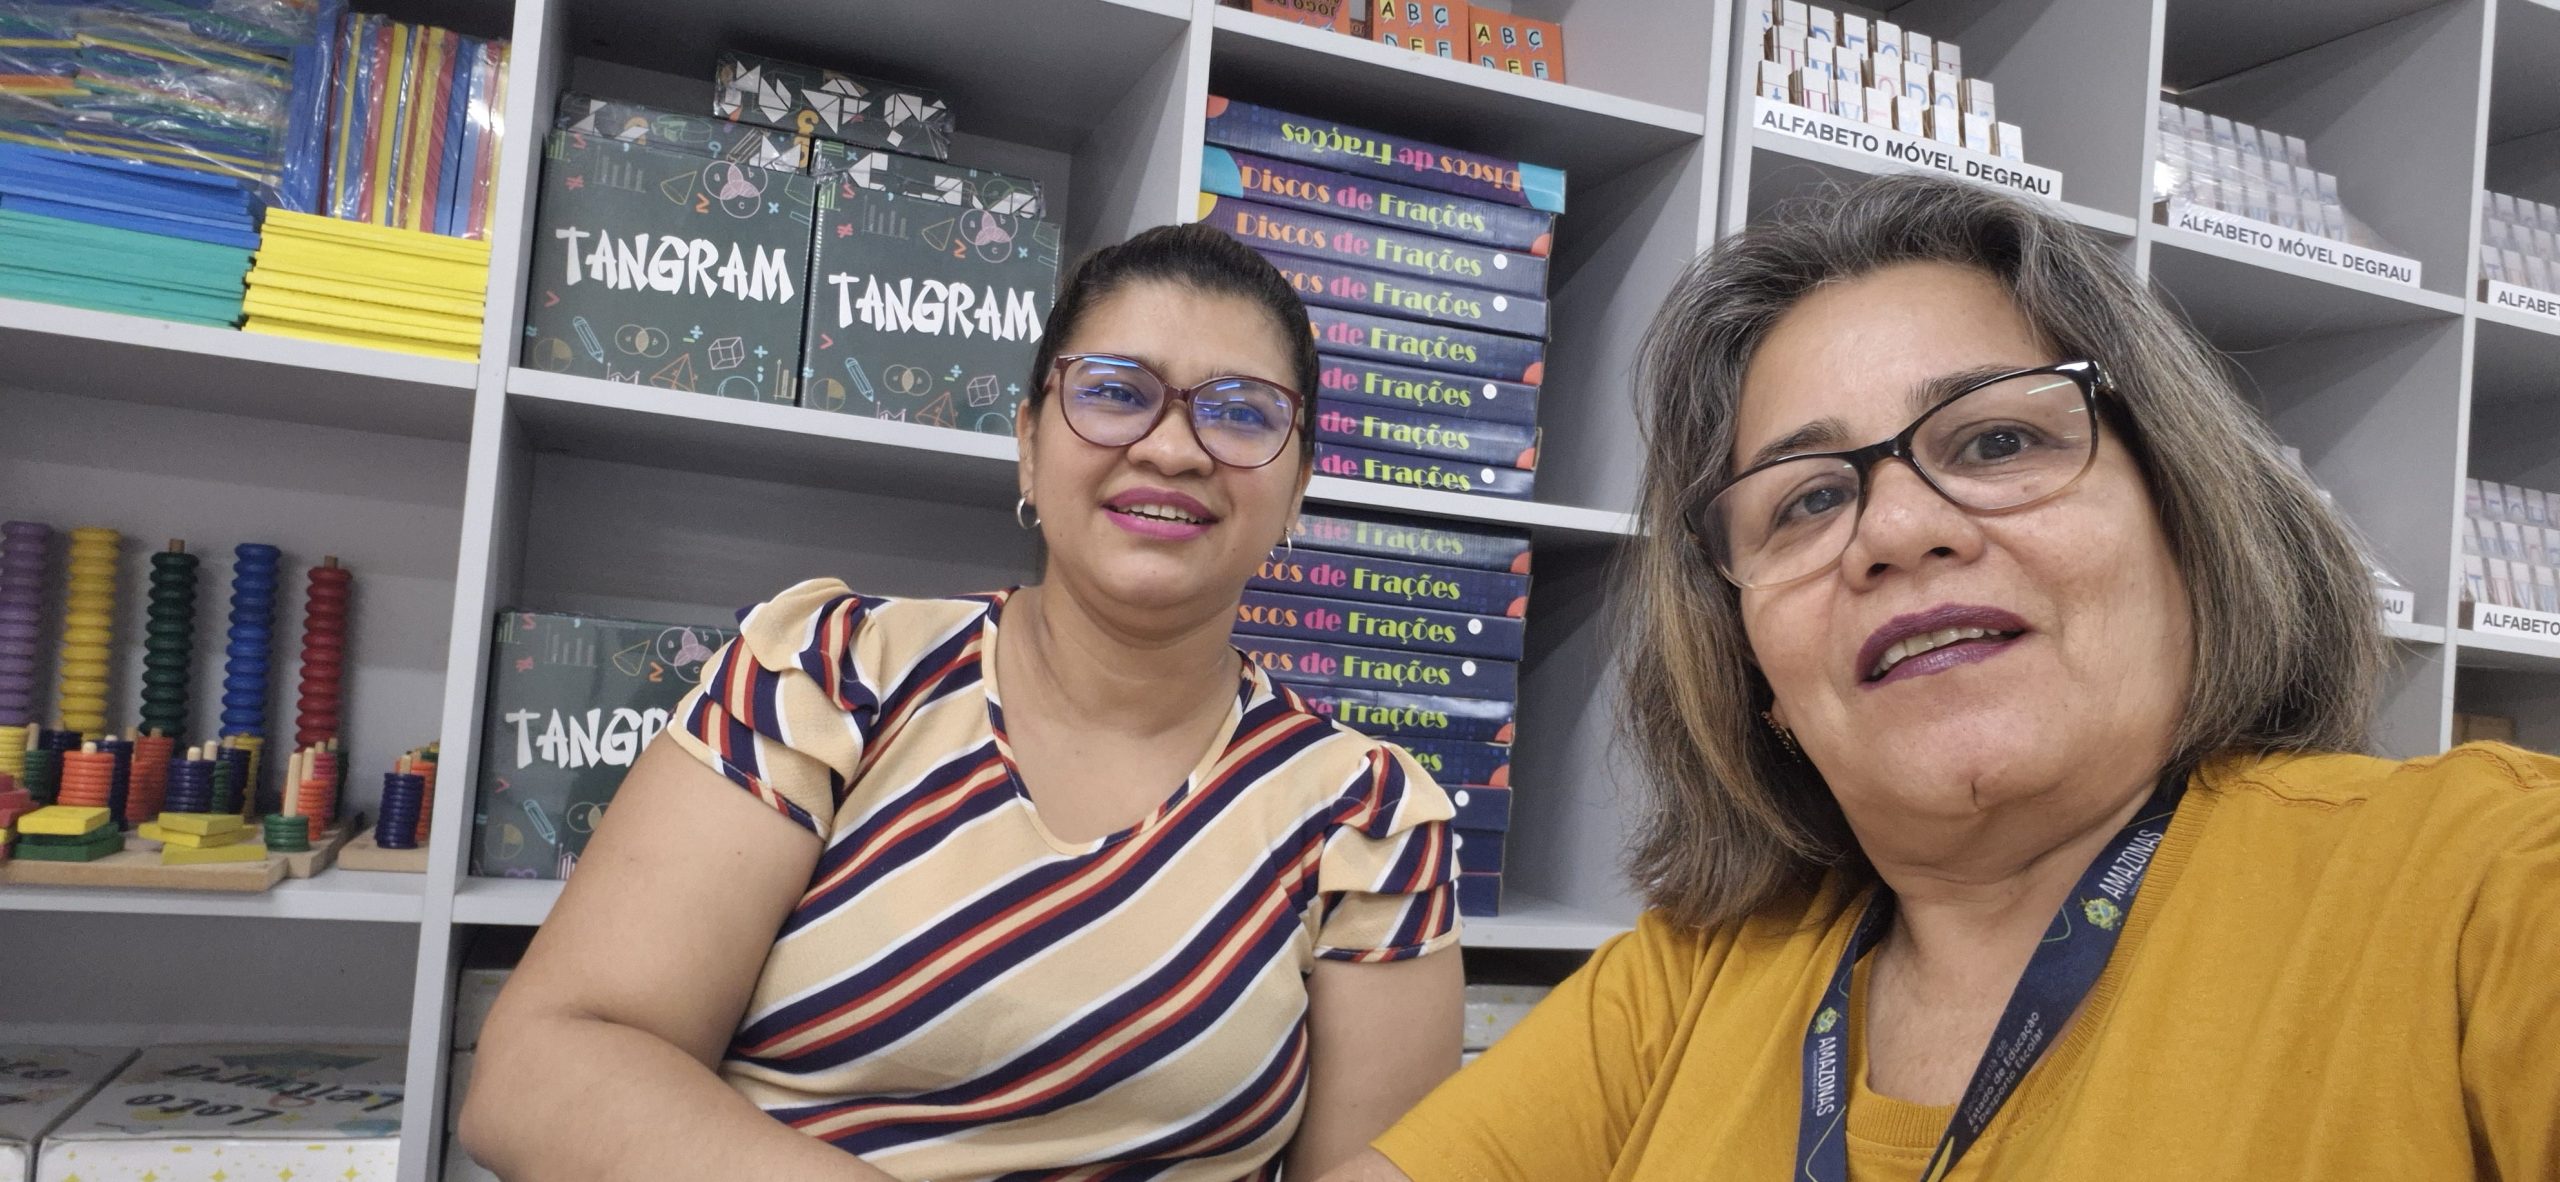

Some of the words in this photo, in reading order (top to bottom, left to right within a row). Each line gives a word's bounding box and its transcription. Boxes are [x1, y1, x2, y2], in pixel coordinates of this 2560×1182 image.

[1281, 122, 1393, 166] Frações
[1397, 147, 1435, 171] de
[1762, 110, 1879, 152] ALFABETO
[1886, 140, 1960, 173] MÓVEL
[1965, 159, 2051, 195] DEGRAU
[1440, 155, 1521, 192] Discos
[1241, 165, 1331, 203] Discos
[1336, 186, 1373, 212] de
[1379, 192, 1486, 233] Frações
[1235, 211, 1327, 249] Discos
[1333, 231, 1370, 257] de
[1375, 238, 1483, 277] Frações
[2180, 213, 2273, 249] ALFABETO
[2279, 238, 2338, 266] MÓVEL
[2342, 256, 2412, 283] DEGRAU
[555, 226, 795, 305] TANGRAM
[828, 272, 1044, 344] TANGRAM
[1330, 276, 1368, 301] de
[1373, 282, 1482, 320] Frações
[1327, 322, 1364, 346] de
[1370, 327, 1477, 363] Frações
[1320, 367, 1358, 391] de
[1365, 372, 1471, 408] Frações
[1319, 411, 1357, 435] de
[1363, 416, 1470, 450] Frações
[1321, 455, 1358, 477] de
[1364, 459, 1472, 492] Frações
[1313, 520, 1350, 541] de
[1356, 522, 1464, 555] Frações
[1309, 563, 1347, 588] de
[1353, 567, 1461, 601] Frações
[1237, 604, 1298, 628] scos
[1304, 608, 1342, 632] de
[1348, 612, 1457, 645] Frações
[1299, 652, 1337, 676] de
[1344, 655, 1450, 687] Frações
[1340, 698, 1448, 731] Frações
[2097, 829, 2165, 900] AMAZONAS
[2014, 1027, 2044, 1069] Escolar
[1816, 1036, 1837, 1117] AMAZONAS
[1968, 1086, 1994, 1127] Estado
[1994, 1067, 2006, 1085] de
